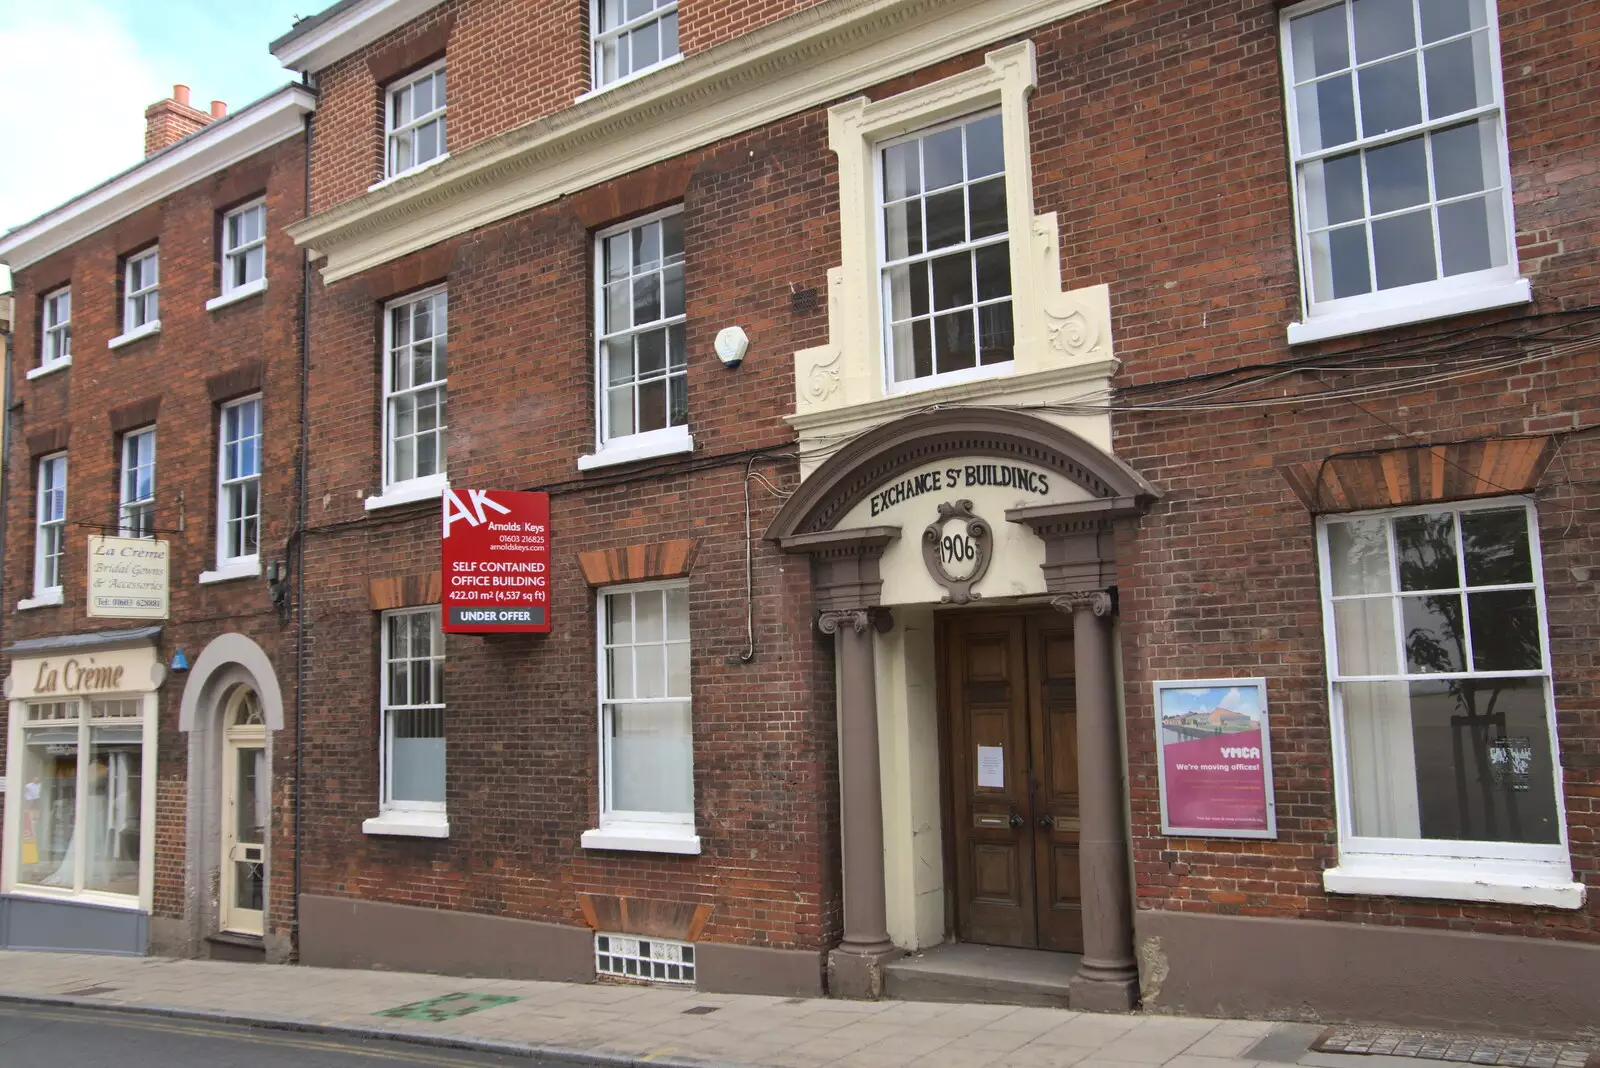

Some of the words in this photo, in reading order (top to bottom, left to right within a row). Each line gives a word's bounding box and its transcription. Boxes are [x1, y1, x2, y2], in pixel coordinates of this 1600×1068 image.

[442, 488, 512, 539] AK
[488, 521, 521, 532] Arnolds
[524, 522, 545, 534] Keys
[499, 535, 520, 543] 01603
[521, 536, 545, 544] 216825
[93, 545, 115, 556] La
[489, 544, 545, 552] arnoldskeys.com
[940, 533, 975, 563] 1906
[94, 562, 129, 574] Bridal
[131, 564, 164, 577] Gowns
[452, 561, 477, 572] SELF
[479, 562, 545, 573] CONTAINED
[93, 578, 105, 588] &
[108, 578, 164, 591] Accessories
[451, 575, 490, 586] OFFICE
[492, 576, 545, 587] BUILDING
[449, 591, 479, 600] 422.01
[495, 591, 520, 602] (4,537
[522, 594, 533, 602] sq
[534, 591, 546, 602] ft)
[460, 611, 497, 621] UNDER
[499, 611, 531, 622] OFFER
[34, 661, 58, 693] La
[63, 657, 124, 691] Crème
[1220, 747, 1260, 759] YMCA
[1176, 763, 1199, 771] We're
[1200, 764, 1229, 772] moving
[1230, 763, 1260, 771] offices!
